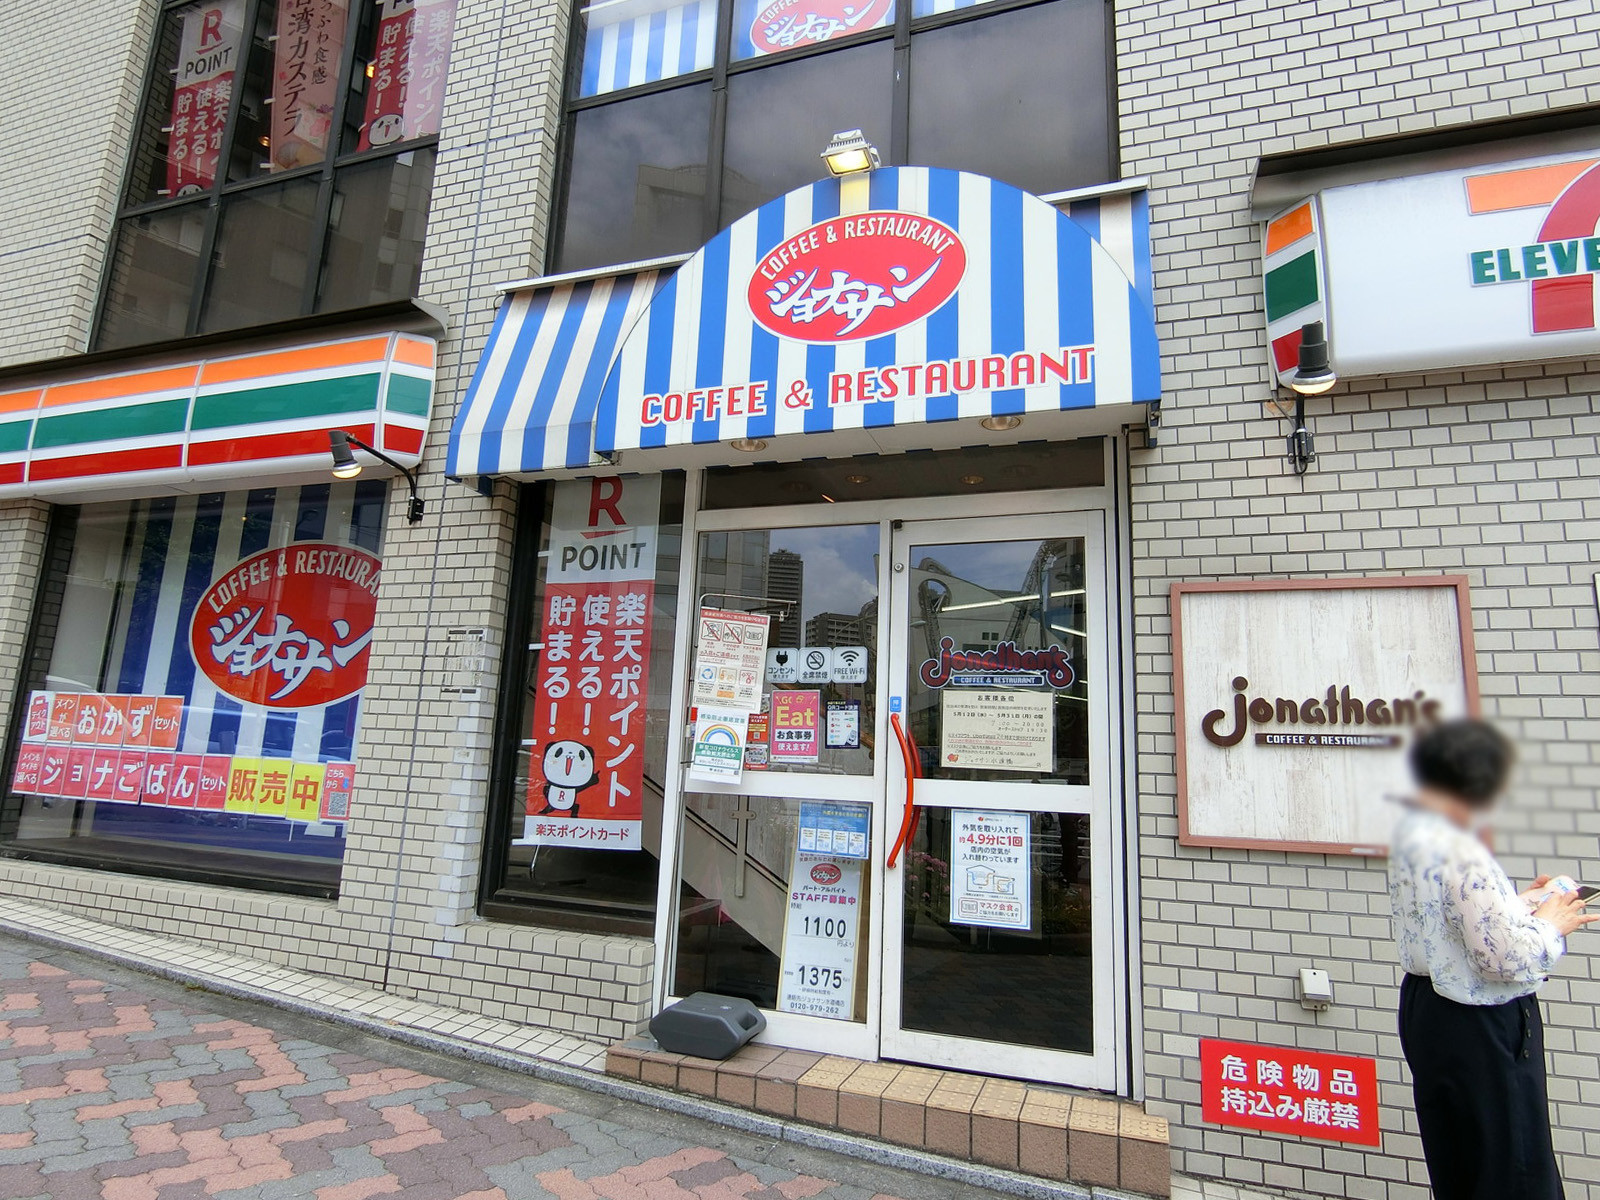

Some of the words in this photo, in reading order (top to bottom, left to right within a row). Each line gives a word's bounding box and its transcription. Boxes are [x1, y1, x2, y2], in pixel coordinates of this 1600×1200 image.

[200, 8, 224, 47] R
[184, 47, 232, 80] POINT
[760, 231, 821, 281] COFFEE
[825, 224, 838, 244] &
[844, 217, 956, 256] RESTAURANT
[764, 256, 943, 337] ジョナサン
[640, 382, 766, 426] COFFEE
[784, 379, 813, 410] &
[829, 346, 1096, 405] RESTAURANT
[587, 475, 628, 528] R
[560, 542, 647, 572] POINT
[208, 558, 271, 614] COFFEE
[276, 553, 288, 577] &
[295, 550, 382, 598] RESTAURA
[209, 605, 373, 700] ジョナサン
[920, 636, 1075, 688] jonathan's
[542, 594, 577, 736] 貯まる！
[576, 593, 612, 736] 使える！
[768, 666, 796, 675] コンセント
[802, 671, 828, 679] 全席禁煙
[833, 667, 848, 675] FREE
[960, 676, 984, 684] COFFEE
[55, 698, 77, 710] メイン
[606, 592, 646, 808] 楽天ポイント
[58, 712, 68, 724] が
[775, 705, 815, 727] Eat
[49, 725, 72, 739] 選べる
[776, 730, 813, 741] お食事券
[1266, 734, 1305, 744] COFFEE
[1308, 735, 1317, 744] &
[16, 771, 38, 784] 選べる
[325, 779, 339, 789] から
[327, 768, 345, 779] こちら
[227, 768, 320, 811] 販売中
[535, 822, 630, 842] 楽天ポイントカード
[959, 832, 1023, 847] 約4.9分に1回
[962, 824, 1019, 835] 外気を取り入れて
[962, 853, 1020, 865] 入れ替わっています
[970, 846, 1011, 856] 店内の空気が
[792, 892, 857, 906] STAFF募集中
[804, 916, 847, 939] 1100
[798, 965, 843, 990] 1375
[1219, 1053, 1358, 1097] 危険物品
[1219, 1085, 1360, 1130] 持込み厳禁
